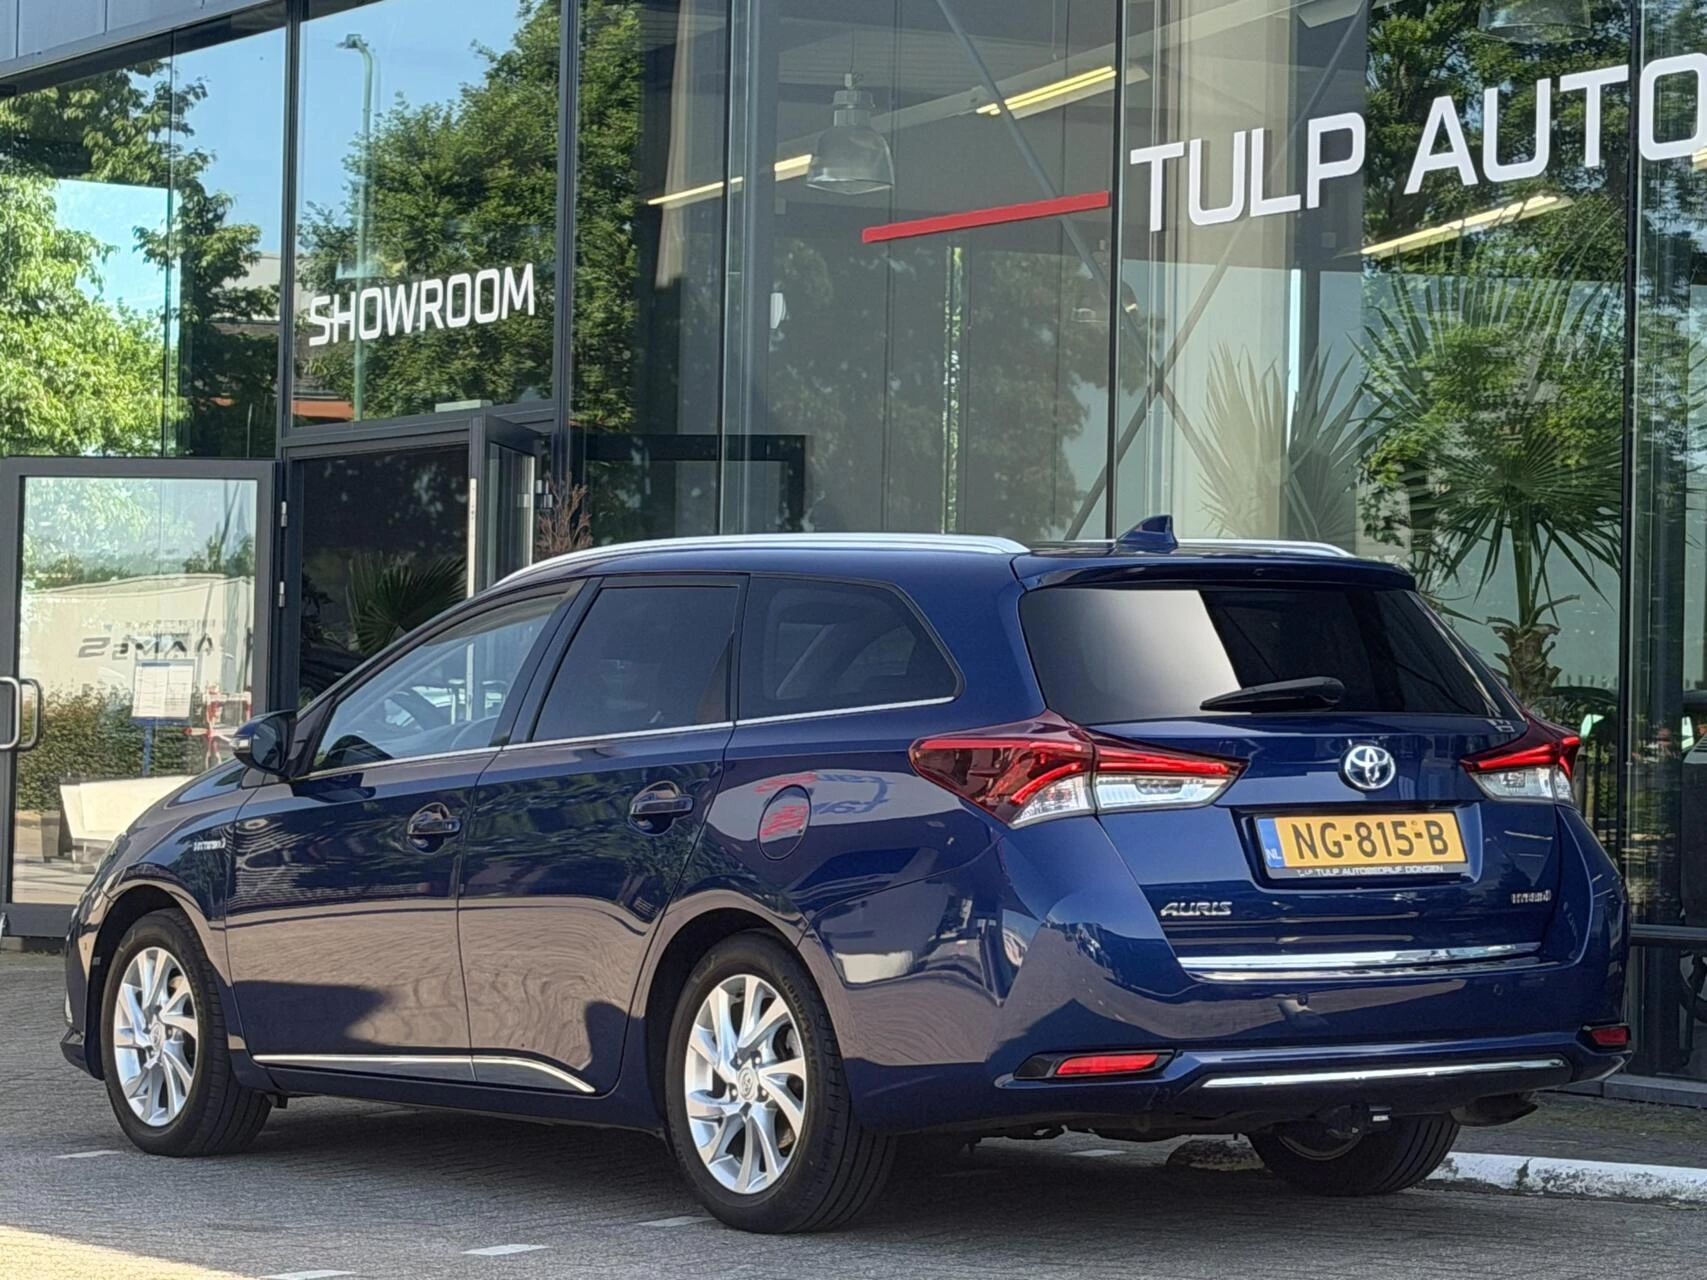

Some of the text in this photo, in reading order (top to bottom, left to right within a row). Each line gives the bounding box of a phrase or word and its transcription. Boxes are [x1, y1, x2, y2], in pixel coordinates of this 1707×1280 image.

[1130, 52, 1707, 232] TULP AUTO
[308, 263, 535, 347] SHOWROOM
[1265, 848, 1282, 860] NL
[1291, 820, 1449, 860] NG-815-B
[1160, 901, 1233, 916] AURIS
